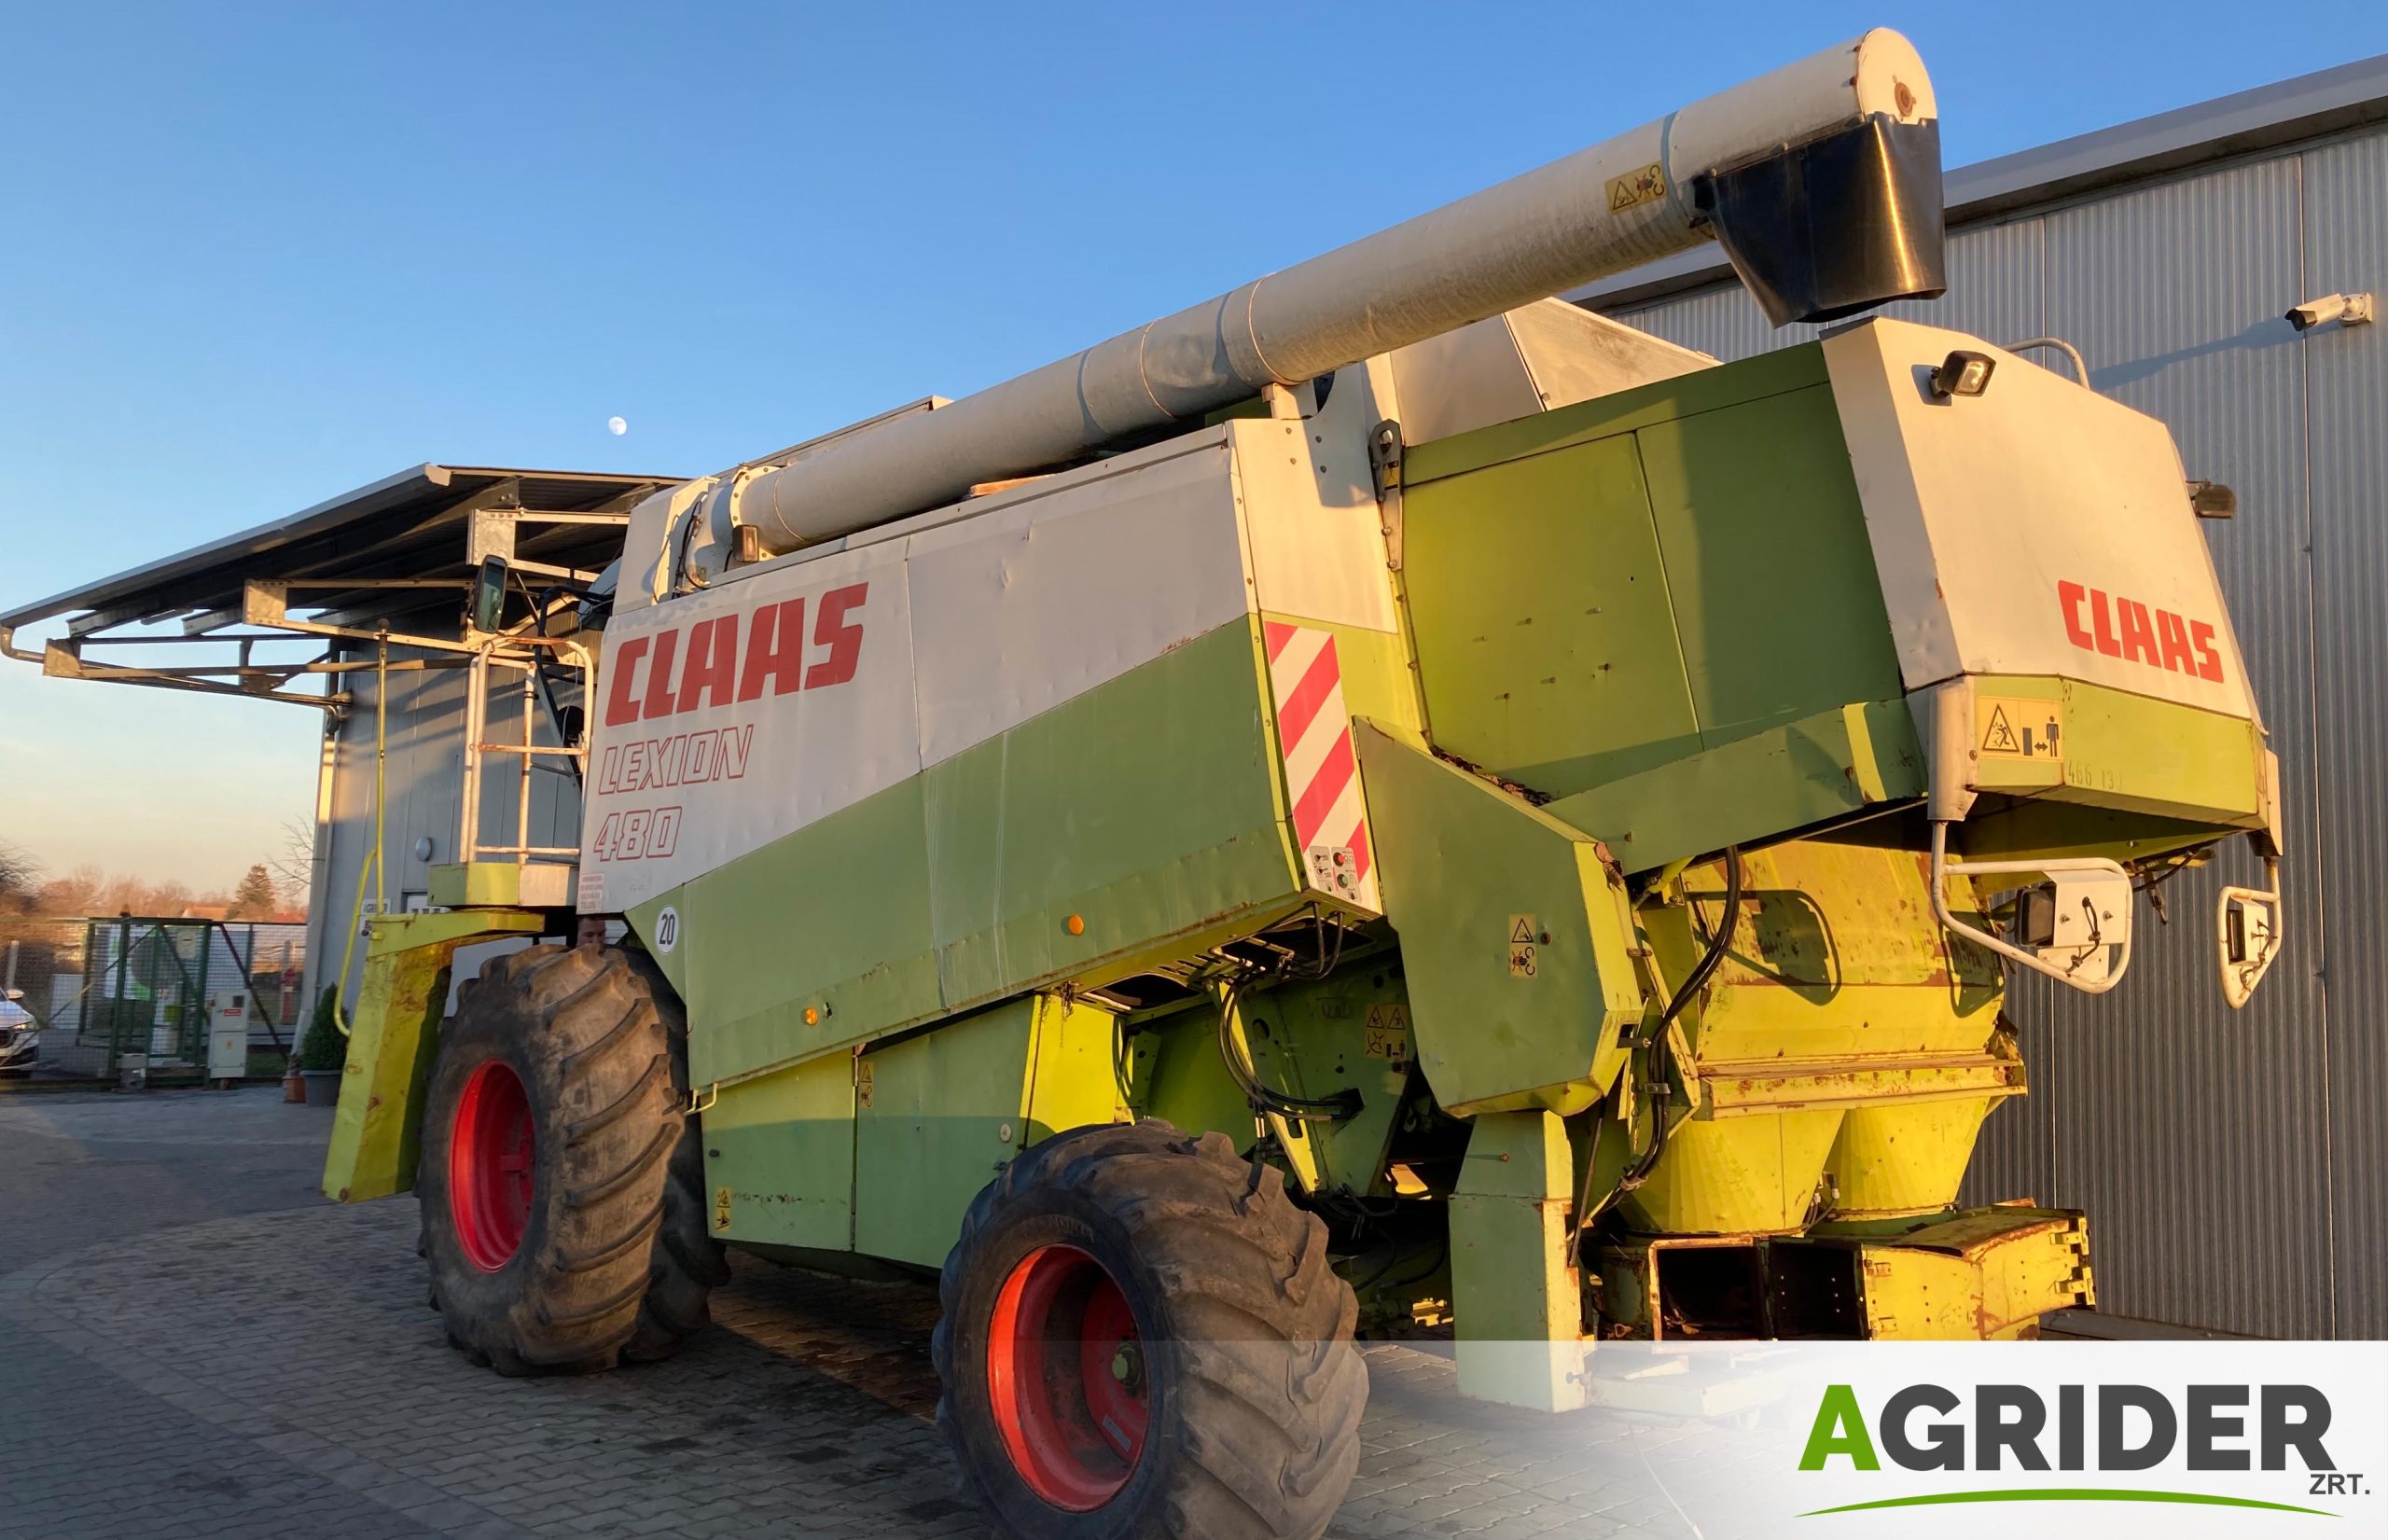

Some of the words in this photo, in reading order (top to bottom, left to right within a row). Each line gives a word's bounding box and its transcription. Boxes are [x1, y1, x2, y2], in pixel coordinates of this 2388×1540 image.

[605, 582, 868, 727] CLAAS
[2058, 580, 2224, 683] CLAAS
[598, 724, 754, 795] LEXION
[593, 806, 682, 862] 480
[659, 913, 675, 945] 20
